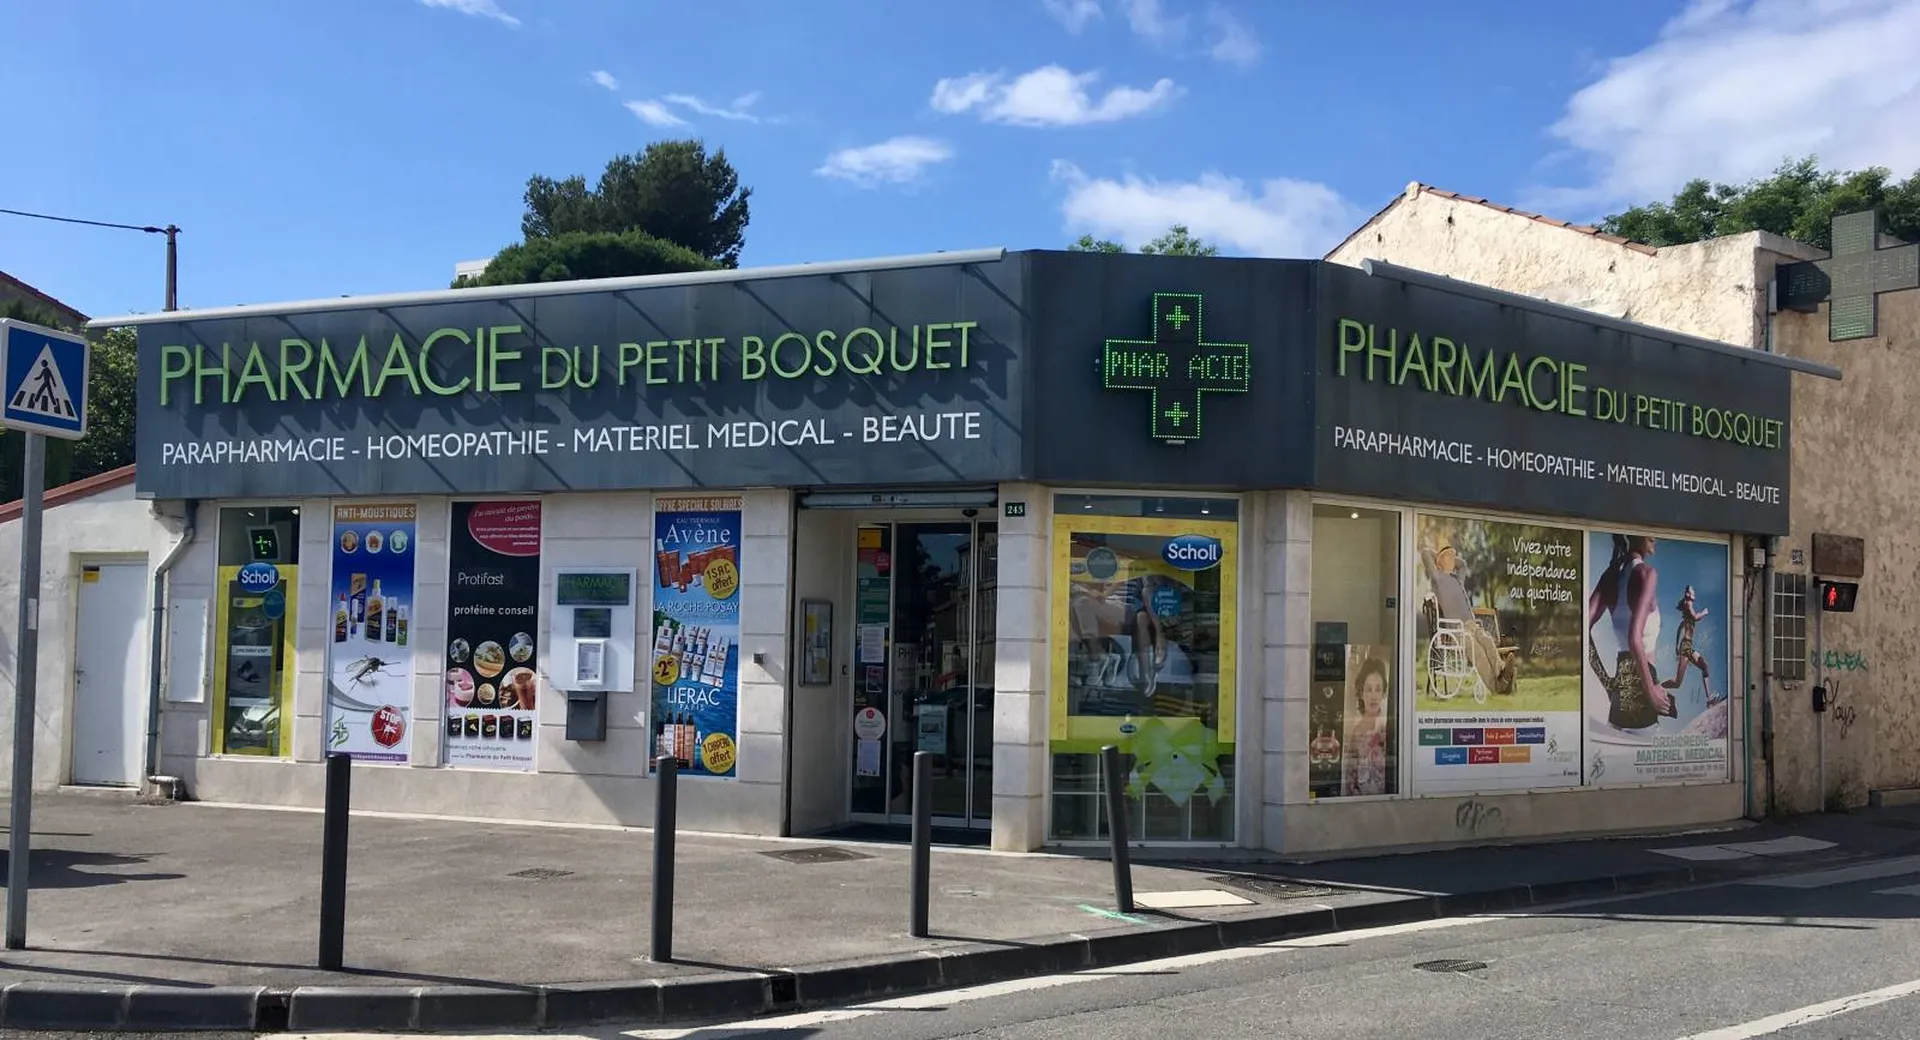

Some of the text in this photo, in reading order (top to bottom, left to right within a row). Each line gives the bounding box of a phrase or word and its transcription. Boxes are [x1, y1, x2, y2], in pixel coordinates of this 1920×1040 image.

[161, 320, 977, 405] PHARMACIE DU PETIT BOSQUET
[1111, 351, 1243, 380] PHAR ACIE
[1337, 318, 1784, 450] PHARMACIE DU PETIT BOSQUET
[162, 437, 345, 465] PARAPHARMACIE
[367, 429, 548, 460] HOMEOPATHIE
[573, 424, 699, 454] MATERIEL
[707, 418, 835, 449] MEDICAL
[863, 412, 981, 443] BEAUTE
[1334, 426, 1473, 464] PARAPHARMACIE
[1487, 447, 1596, 480] HOMEOPATHIE
[1607, 463, 1669, 489] MATERIEL
[1672, 473, 1726, 497] MEDICAL
[1736, 481, 1780, 504] BEAUTE
[336, 507, 415, 519] ANTI-MOUSTIQUES
[664, 524, 731, 543] Avène
[1168, 543, 1217, 561] Scholl
[1512, 537, 1572, 557] Vivez votre
[241, 569, 275, 585] Scholl
[457, 572, 504, 585] Protifast
[712, 563, 731, 579] SAC
[1506, 557, 1577, 586] indépendance
[711, 575, 733, 592] offert
[1510, 583, 1573, 609] au quotidien
[454, 604, 534, 617] protéine conseil
[667, 687, 721, 705] LIERAC
[379, 710, 401, 725] STOP
[709, 750, 731, 765] offert
[1636, 747, 1724, 762] MATERIEL MEDICAL
